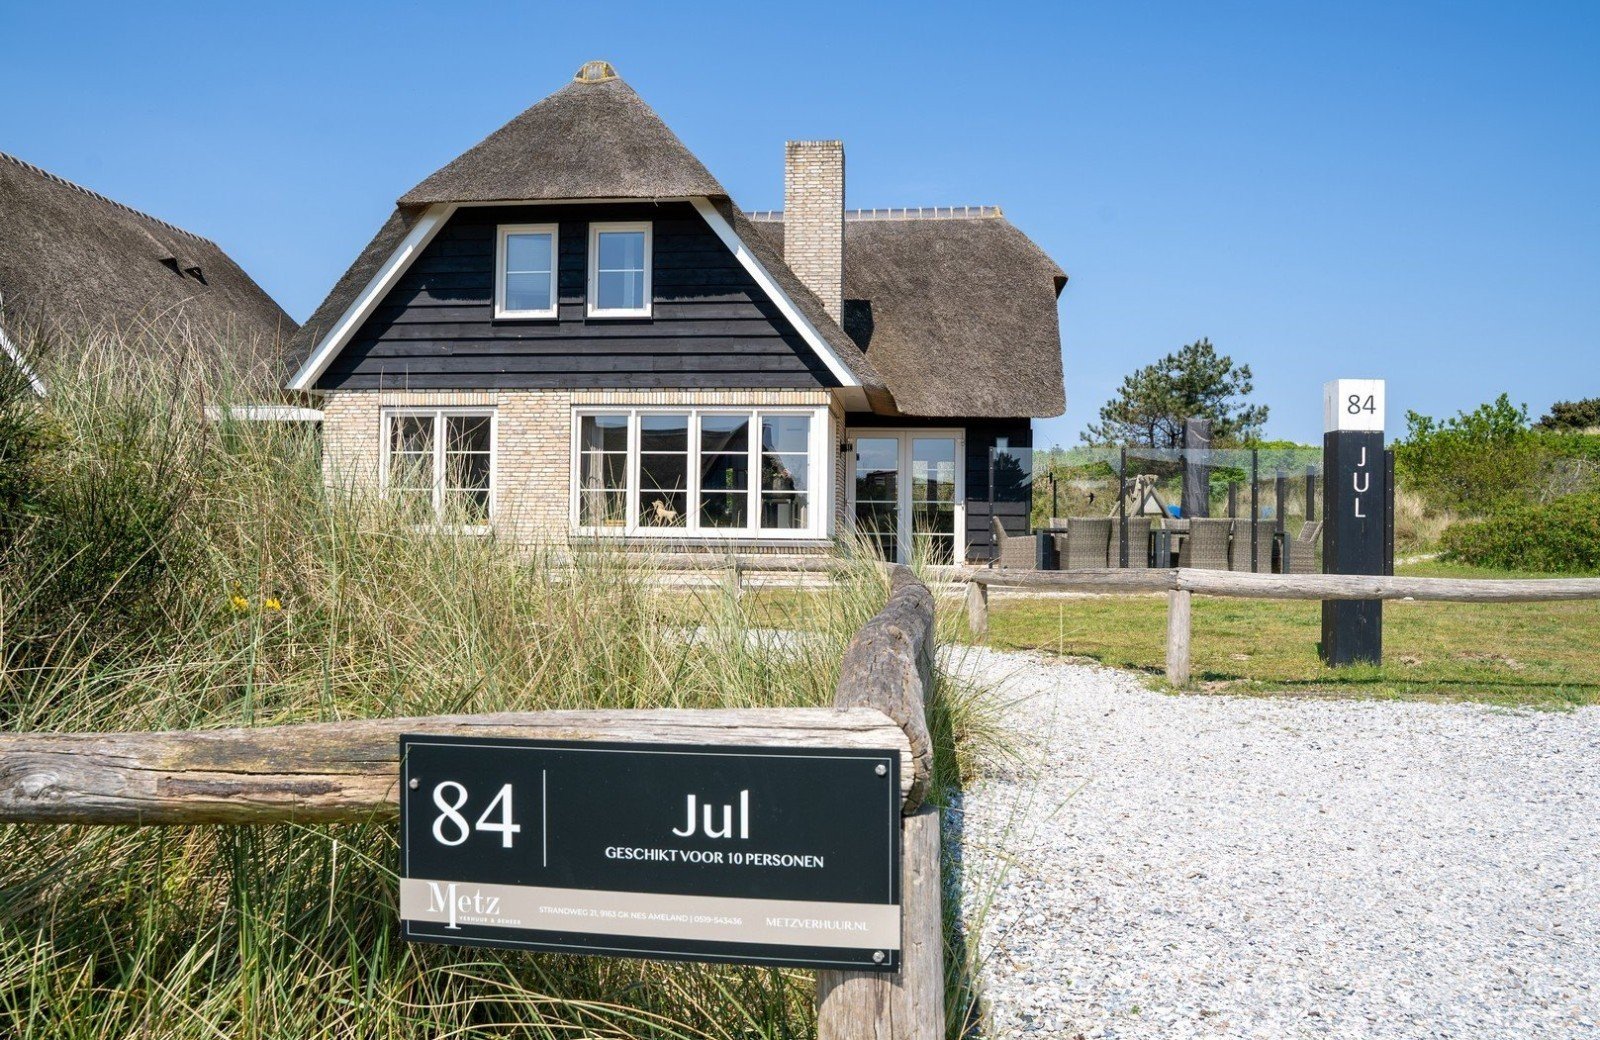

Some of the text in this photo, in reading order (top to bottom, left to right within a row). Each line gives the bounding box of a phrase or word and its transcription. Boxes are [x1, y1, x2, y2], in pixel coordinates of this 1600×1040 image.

[1347, 394, 1377, 415] 84
[431, 780, 522, 849] 84
[671, 789, 750, 840] Jul
[604, 846, 825, 869] GESCHIKT VOOR 10 PERSONEN
[426, 881, 501, 930] Metz
[539, 906, 589, 917] STRANDWEG
[630, 912, 647, 921] NES
[647, 912, 689, 924] AMELAND
[765, 917, 870, 932] METZVERHUUR.NL
